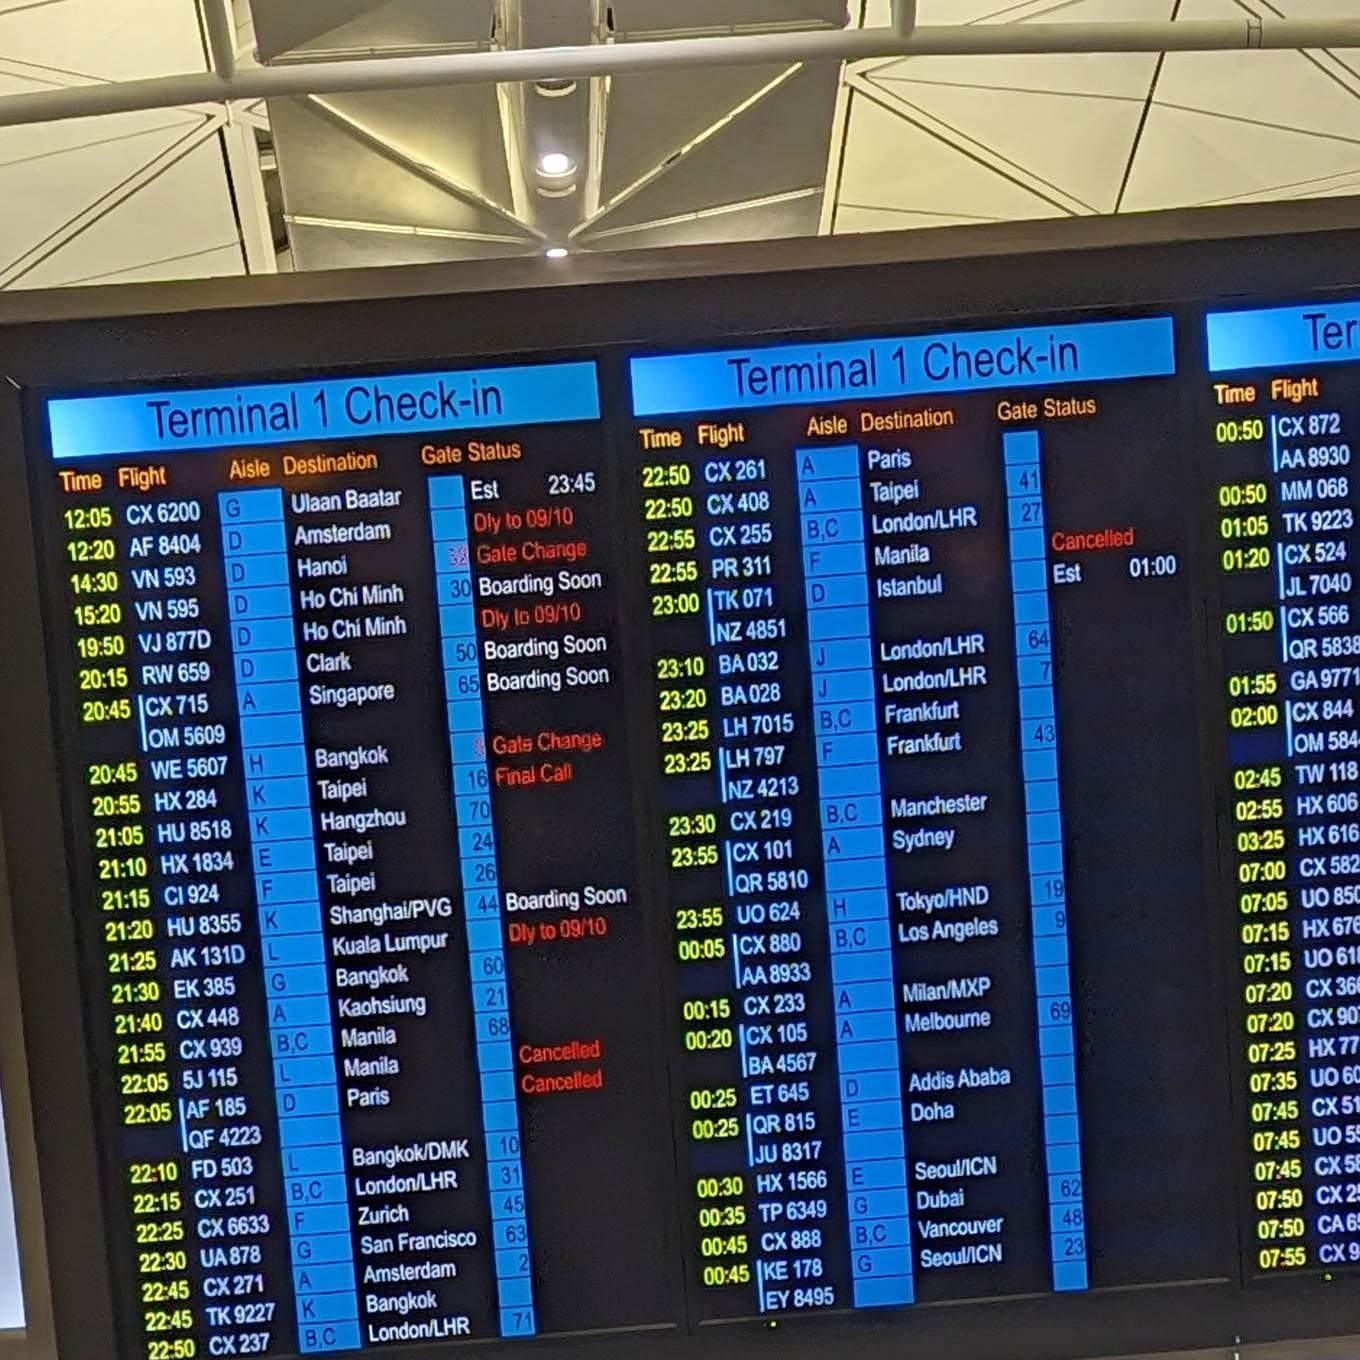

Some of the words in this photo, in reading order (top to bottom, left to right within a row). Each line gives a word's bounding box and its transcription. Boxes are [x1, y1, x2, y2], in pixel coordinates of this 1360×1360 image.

[727, 348, 876, 396] Terminal
[892, 346, 905, 384] 1
[923, 334, 1078, 381] Check-in
[146, 391, 298, 439] Terminal
[313, 389, 327, 427] 1
[345, 378, 502, 425] Check-in
[1215, 419, 1263, 443] 00:50
[58, 470, 102, 492] Time
[118, 465, 167, 491] Flight
[229, 457, 271, 480] Aisle
[282, 451, 378, 476] Destination
[421, 445, 462, 465] Gate
[467, 441, 521, 462] Status
[642, 464, 690, 488] 22:50
[705, 461, 732, 482] CX
[735, 459, 765, 480] 261
[868, 448, 911, 469] Paris
[64, 507, 112, 529] 12:05
[126, 504, 154, 525] CX
[157, 501, 200, 523] 6200
[291, 493, 342, 513] Ulaan
[345, 489, 402, 509] Baatar
[470, 480, 499, 500] Est
[548, 472, 595, 494] 23:45
[294, 521, 391, 545] Amsterdam
[473, 512, 501, 534] Dly
[505, 512, 522, 529] to
[525, 507, 573, 528] 09/10
[1220, 515, 1268, 538] 01:05
[874, 543, 929, 565] Manila
[1052, 528, 1134, 551] Cancelled
[877, 573, 942, 597] Istanbul
[1053, 563, 1081, 583] Est
[1129, 555, 1176, 577] 01:00
[74, 603, 121, 625] 15:20
[478, 574, 554, 596] Boarding
[558, 570, 602, 590] Soon
[83, 698, 131, 722] 20:45
[309, 684, 394, 707] Singapore
[885, 700, 959, 723] Frankfurt
[669, 813, 716, 836] 23:30
[891, 794, 987, 817] Manchester
[893, 828, 954, 852] Sydney
[99, 856, 147, 879] 21:10
[329, 897, 452, 926] Shanghai/PVG
[896, 885, 988, 913] Tokyo/HND
[114, 1012, 162, 1034] 21:40
[338, 994, 426, 1017] Kaohsiung
[905, 1011, 990, 1031] Melbourne
[519, 1039, 600, 1063] Cancelled
[690, 1088, 737, 1110] 00:25
[911, 1101, 954, 1121] Doha
[1251, 1100, 1299, 1122] 07:45
[352, 1139, 469, 1168] Bangkok/DMK
[917, 1188, 964, 1209] Dubai
[361, 1235, 394, 1254] San
[398, 1229, 477, 1251] Francisco
[701, 1234, 748, 1256] 00:45
[918, 1218, 1003, 1238] Vancouver
[1259, 1246, 1306, 1268] 07:55
[148, 1338, 195, 1360] 22:50
[368, 1316, 470, 1342] London/LHR
